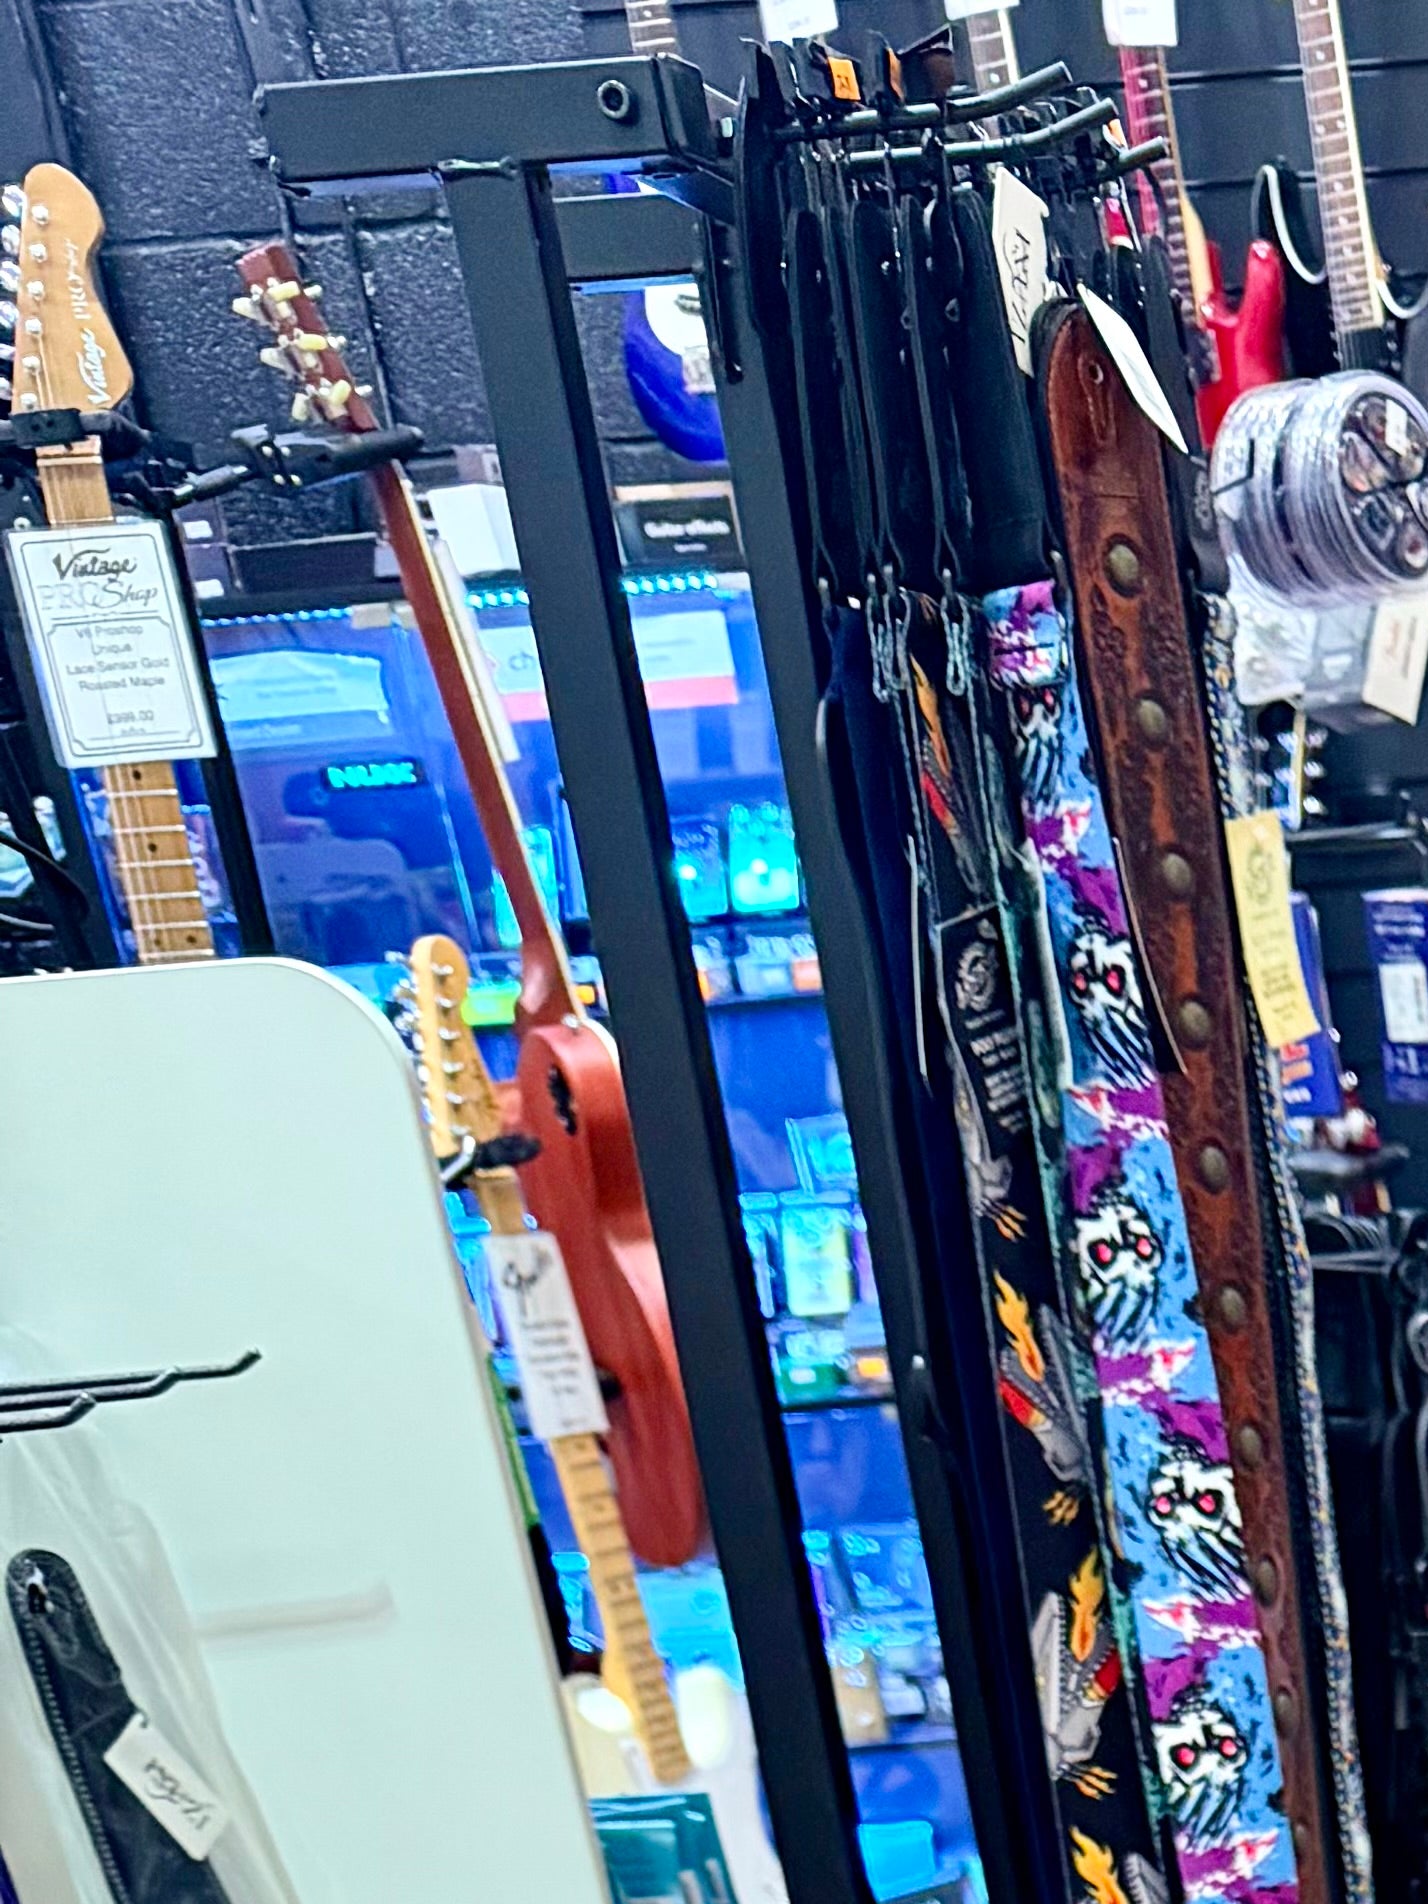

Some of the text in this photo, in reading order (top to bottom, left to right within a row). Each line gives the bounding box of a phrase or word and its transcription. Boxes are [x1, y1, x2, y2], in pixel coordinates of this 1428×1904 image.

[75, 327, 113, 405] Vintage
[52, 547, 138, 581] Vintage
[66, 662, 96, 676] Lace
[97, 660, 139, 673] Sensor
[129, 675, 166, 690] Maple
